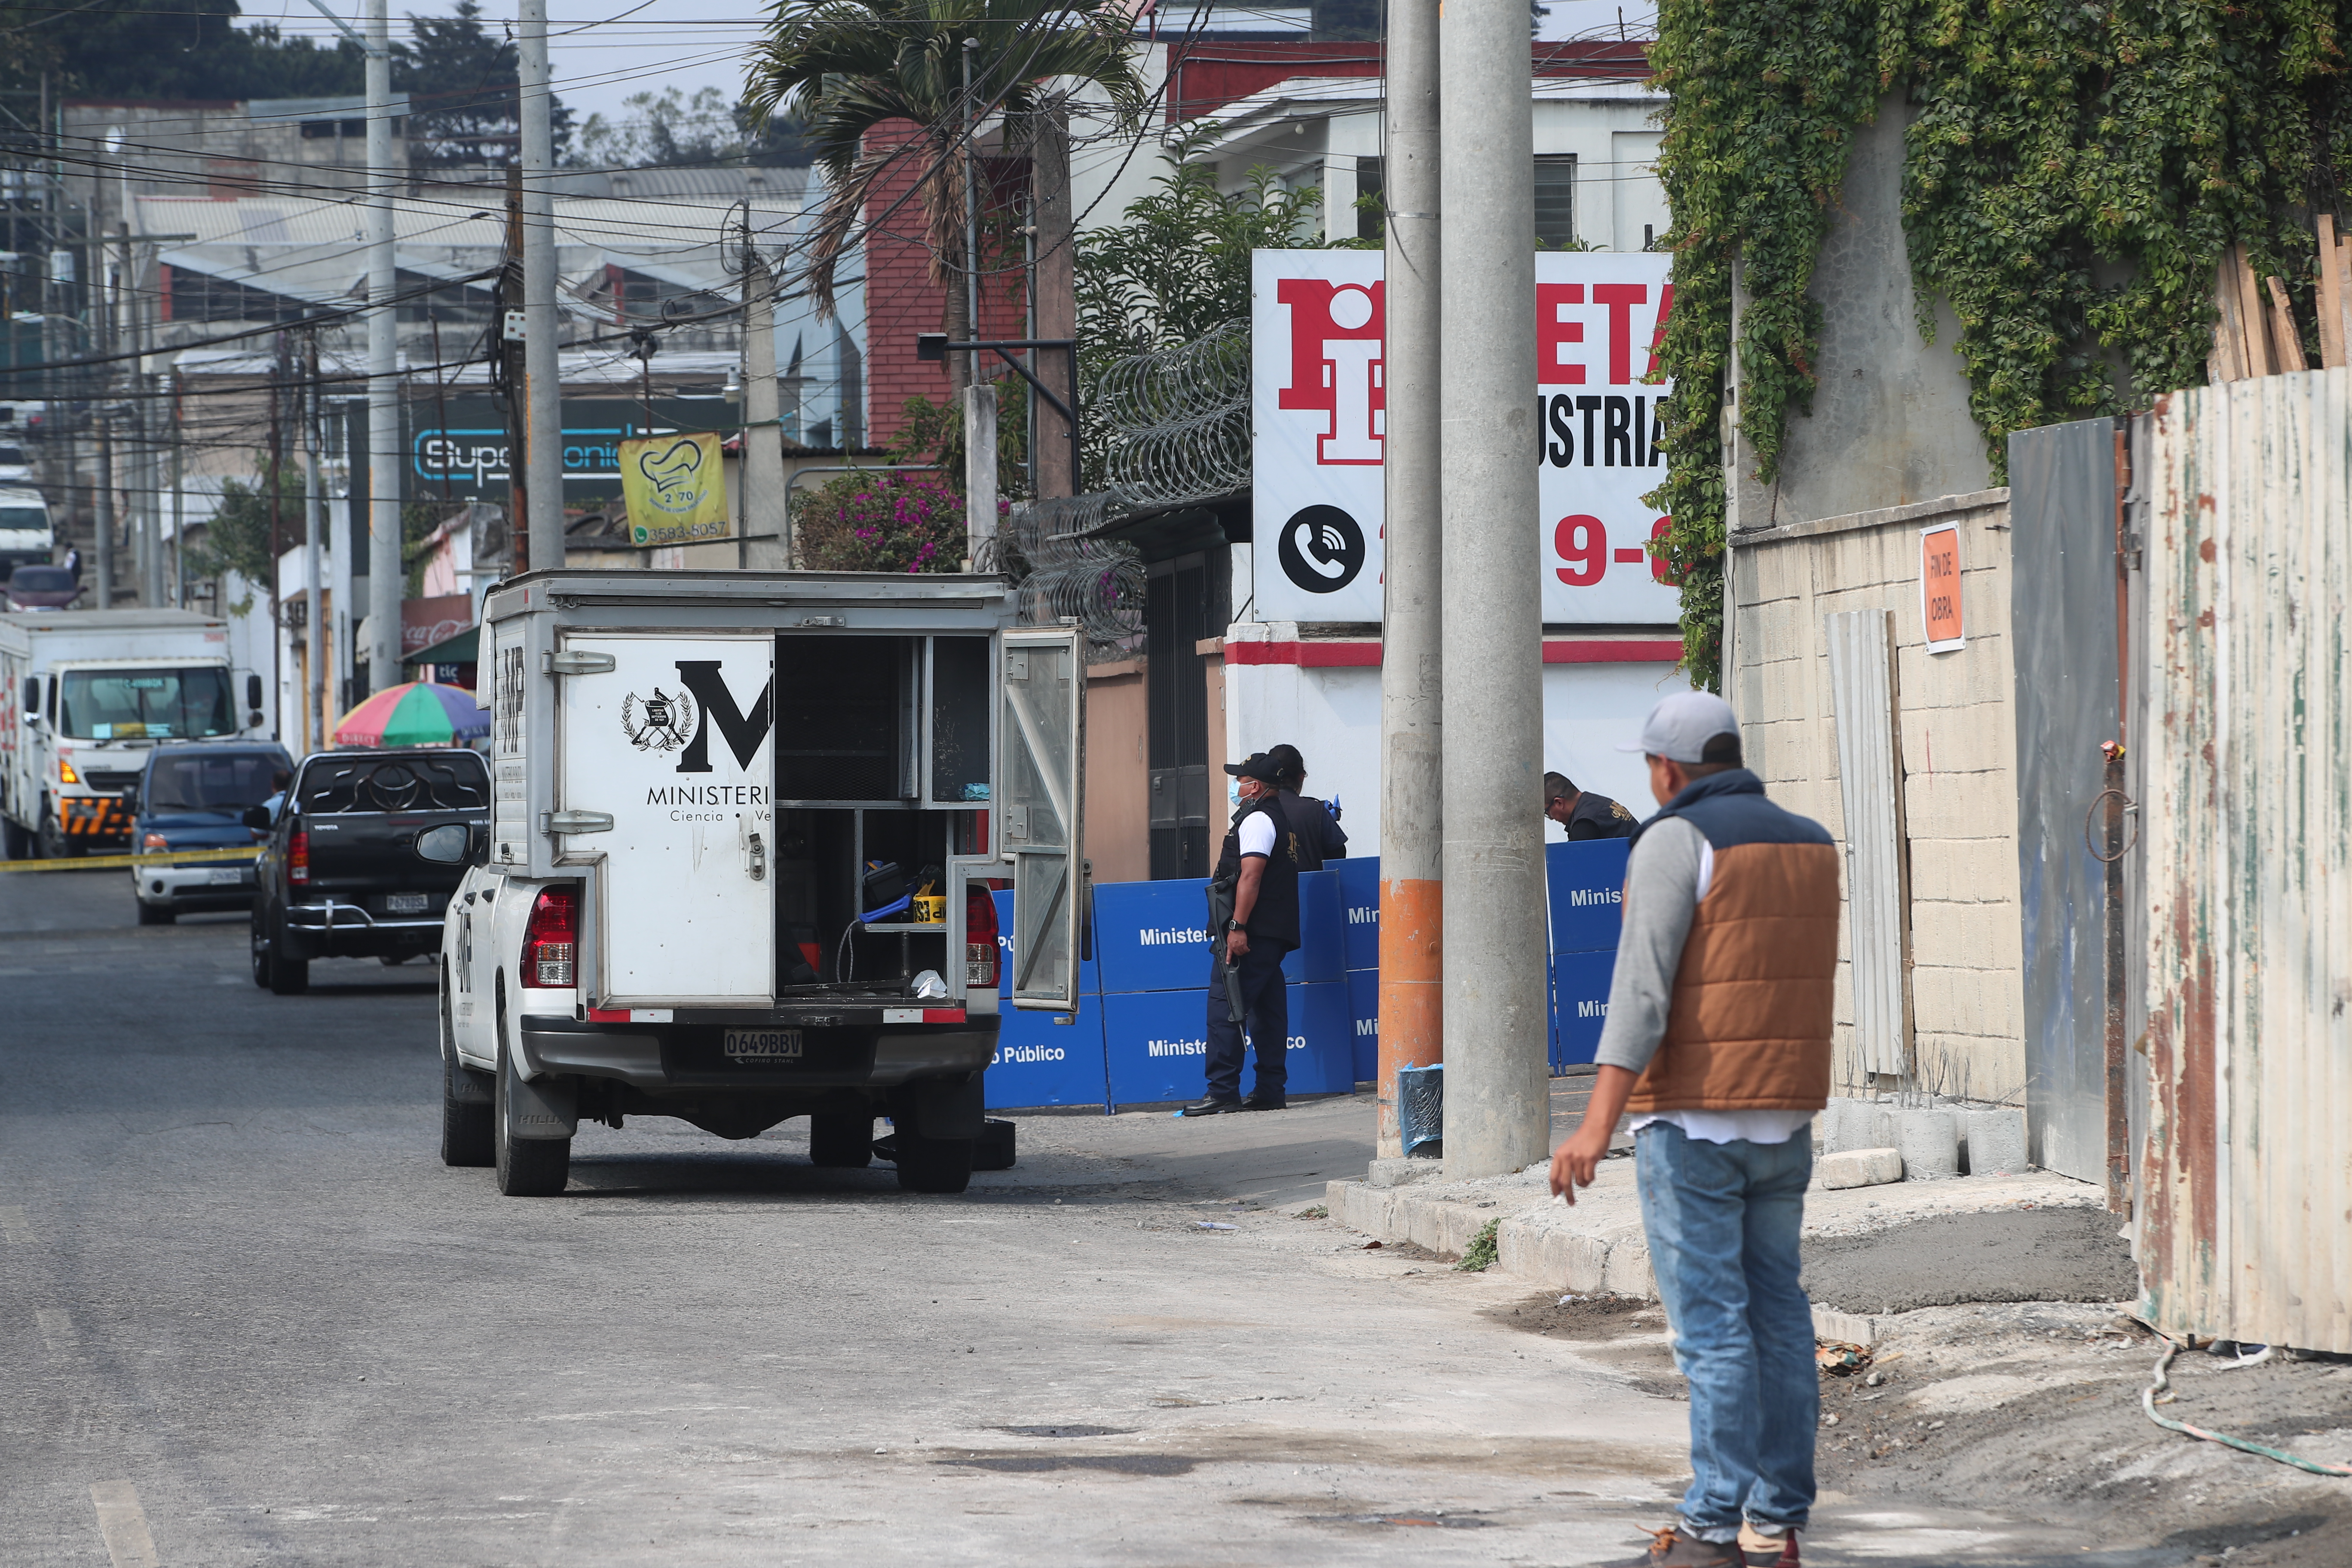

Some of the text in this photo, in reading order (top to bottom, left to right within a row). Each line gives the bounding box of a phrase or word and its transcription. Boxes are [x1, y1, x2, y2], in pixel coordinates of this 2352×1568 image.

[1930, 552, 1952, 579] FIN DE
[1932, 595, 1954, 622] OBRA
[647, 786, 769, 805] MINISTERI
[670, 810, 772, 821] Ciencia Ve
[1571, 887, 1625, 906] Minis
[1004, 1044, 1065, 1063] Público
